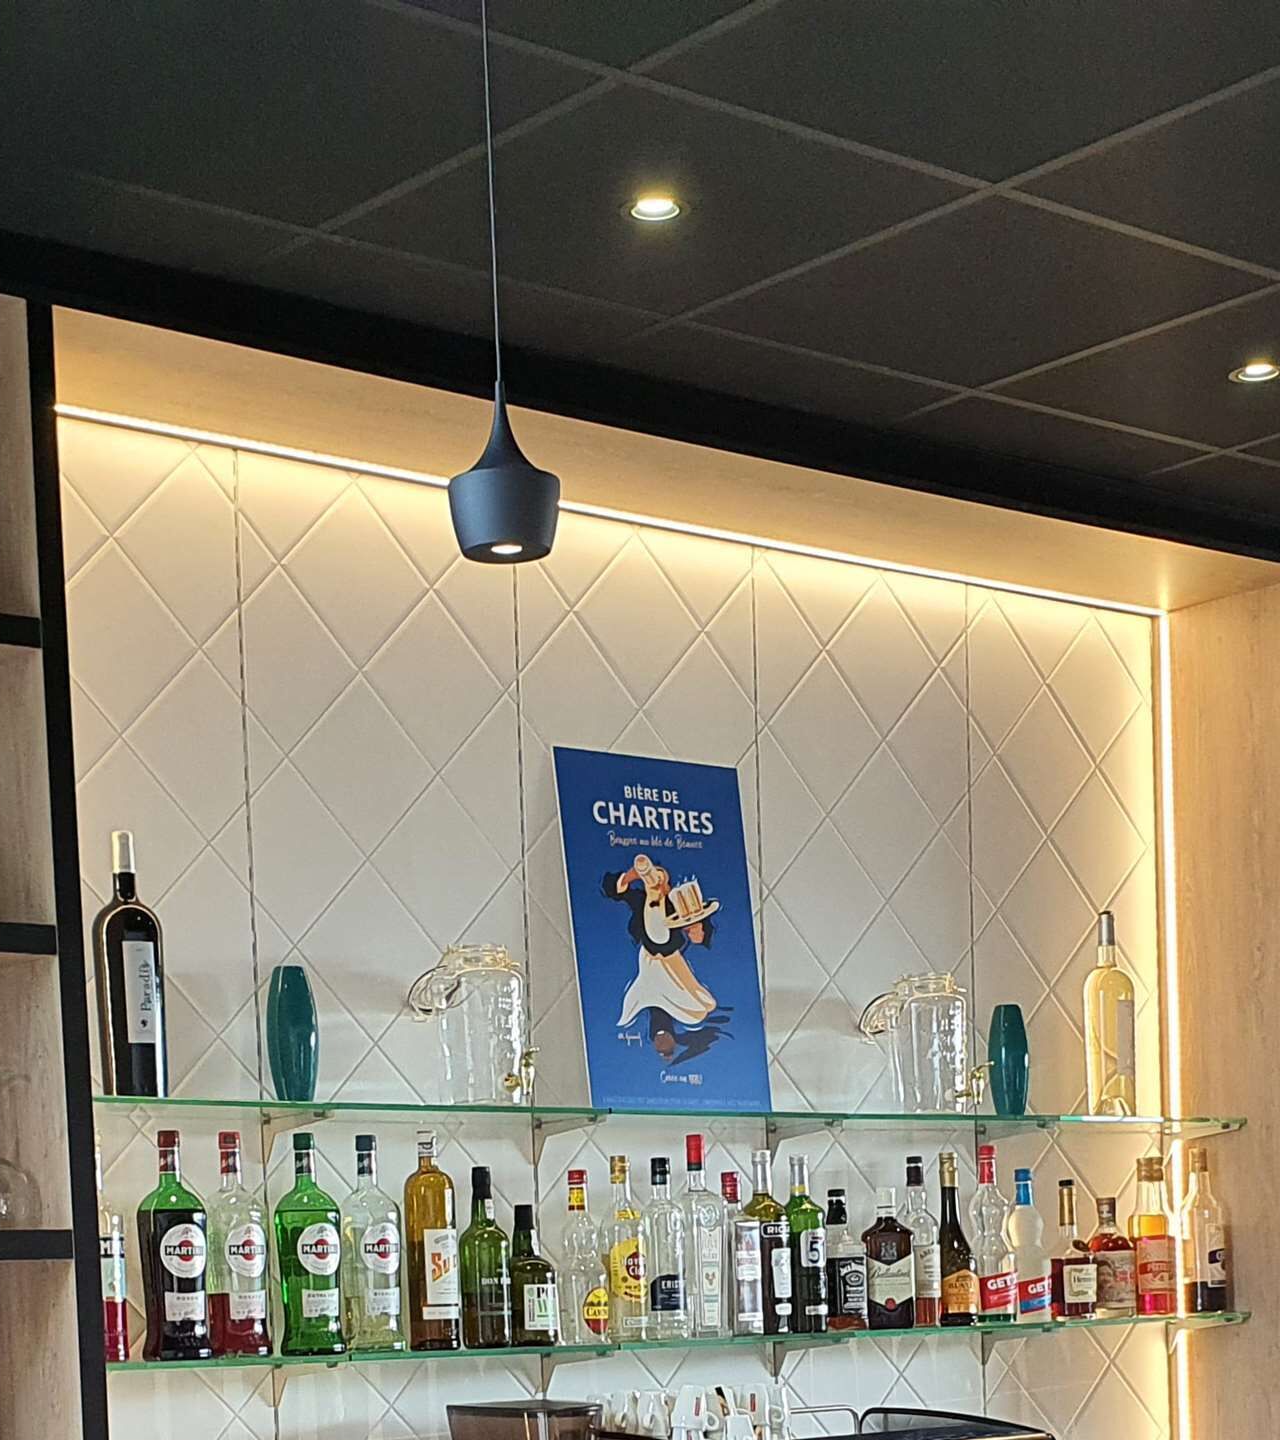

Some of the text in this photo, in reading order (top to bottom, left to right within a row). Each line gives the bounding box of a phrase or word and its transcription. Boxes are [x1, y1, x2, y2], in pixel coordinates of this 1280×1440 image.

[623, 784, 680, 804] BIÈRE DE
[592, 800, 714, 835] CHARTRES
